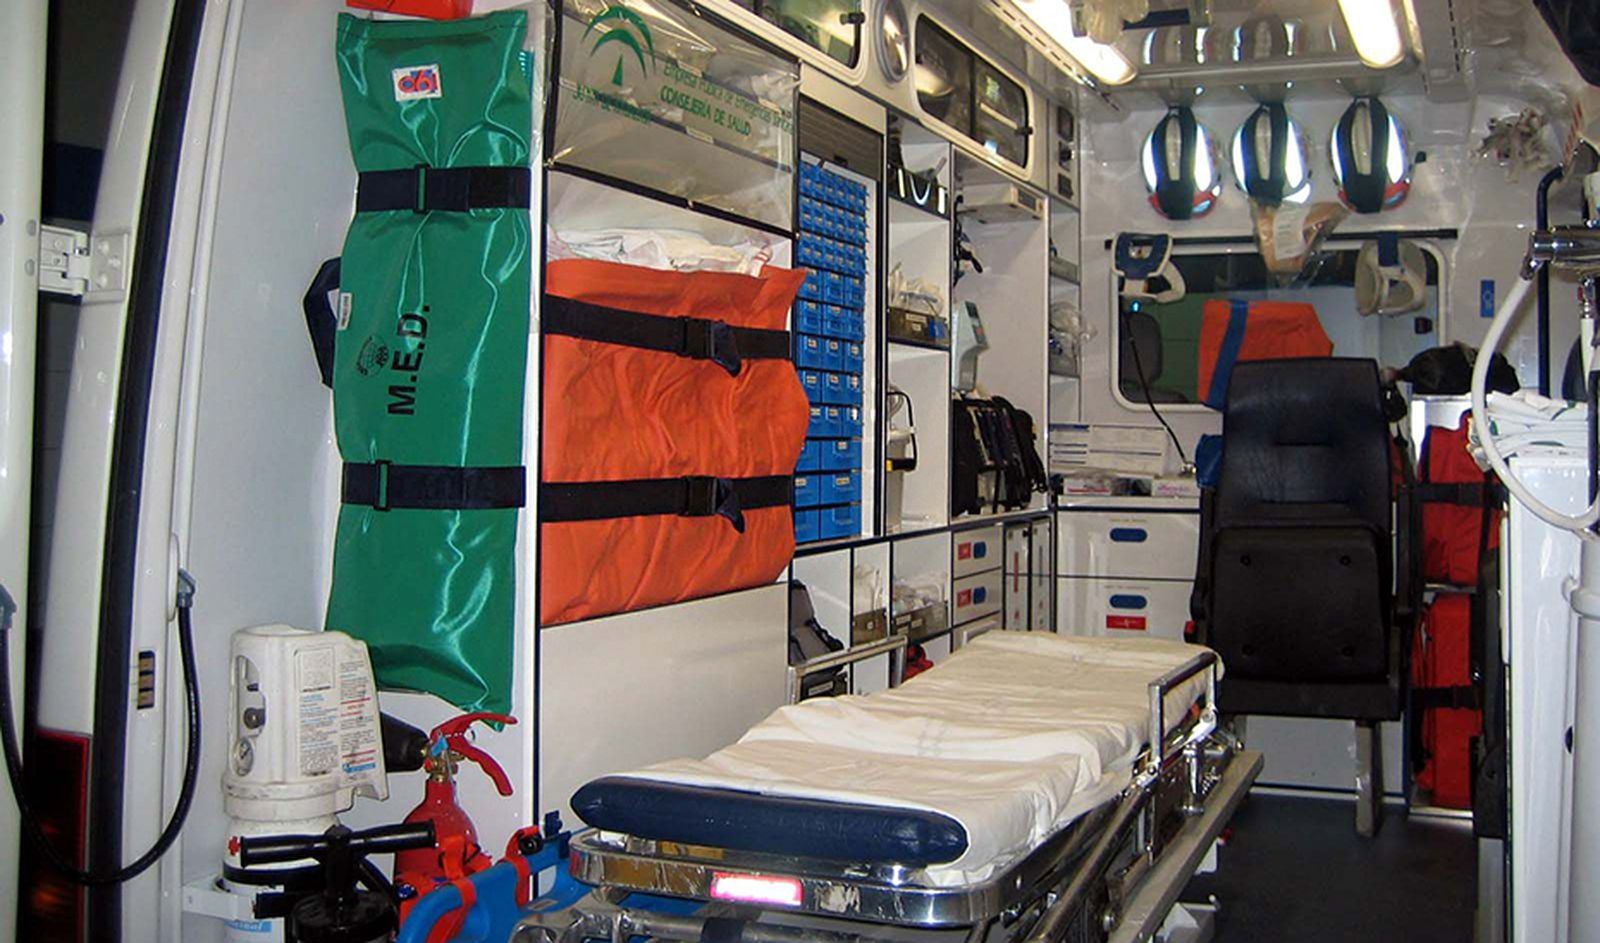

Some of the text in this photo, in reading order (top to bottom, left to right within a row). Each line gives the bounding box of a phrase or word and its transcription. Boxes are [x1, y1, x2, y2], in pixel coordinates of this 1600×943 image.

[713, 107, 726, 126] DE
[727, 114, 752, 137] SALUD
[387, 304, 430, 415] M.E.D.
